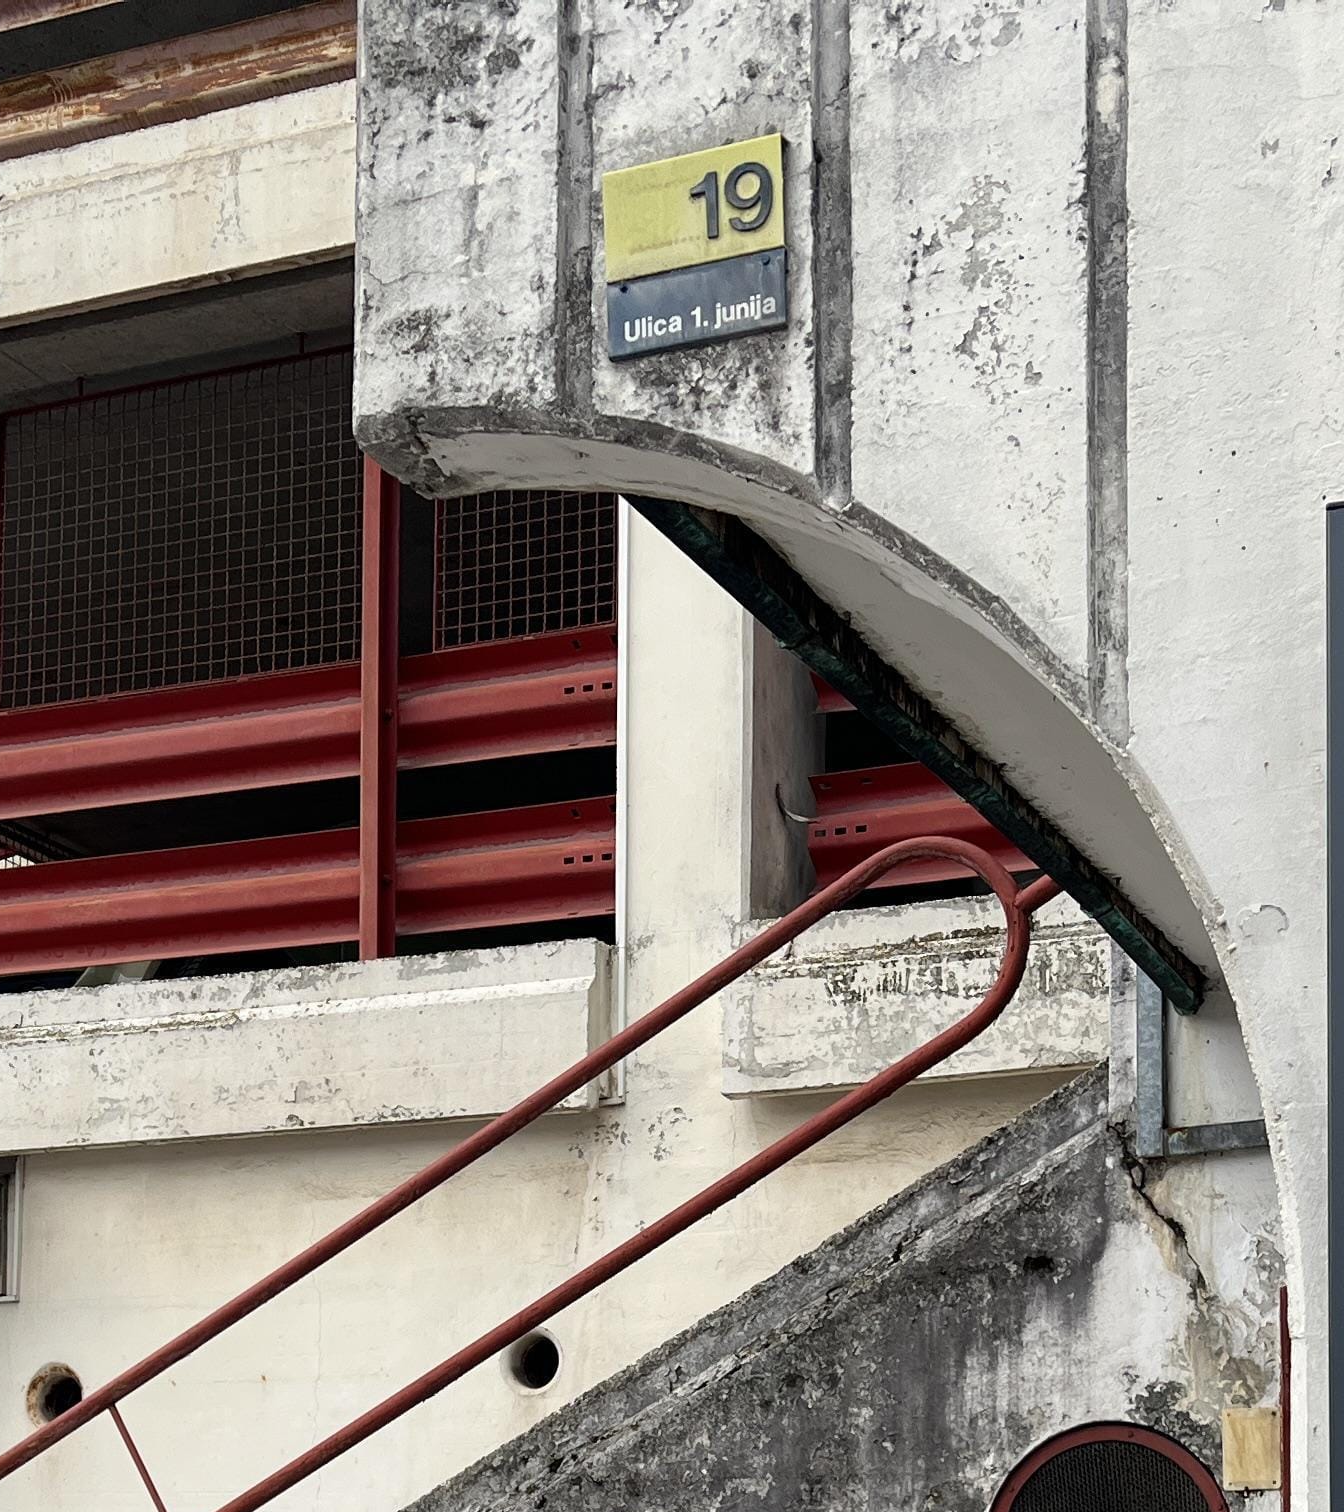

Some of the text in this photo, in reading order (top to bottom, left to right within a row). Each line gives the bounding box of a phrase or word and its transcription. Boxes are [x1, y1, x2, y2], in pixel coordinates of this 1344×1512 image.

[689, 161, 774, 240] 19
[623, 294, 777, 343] Ulica 1. junija
